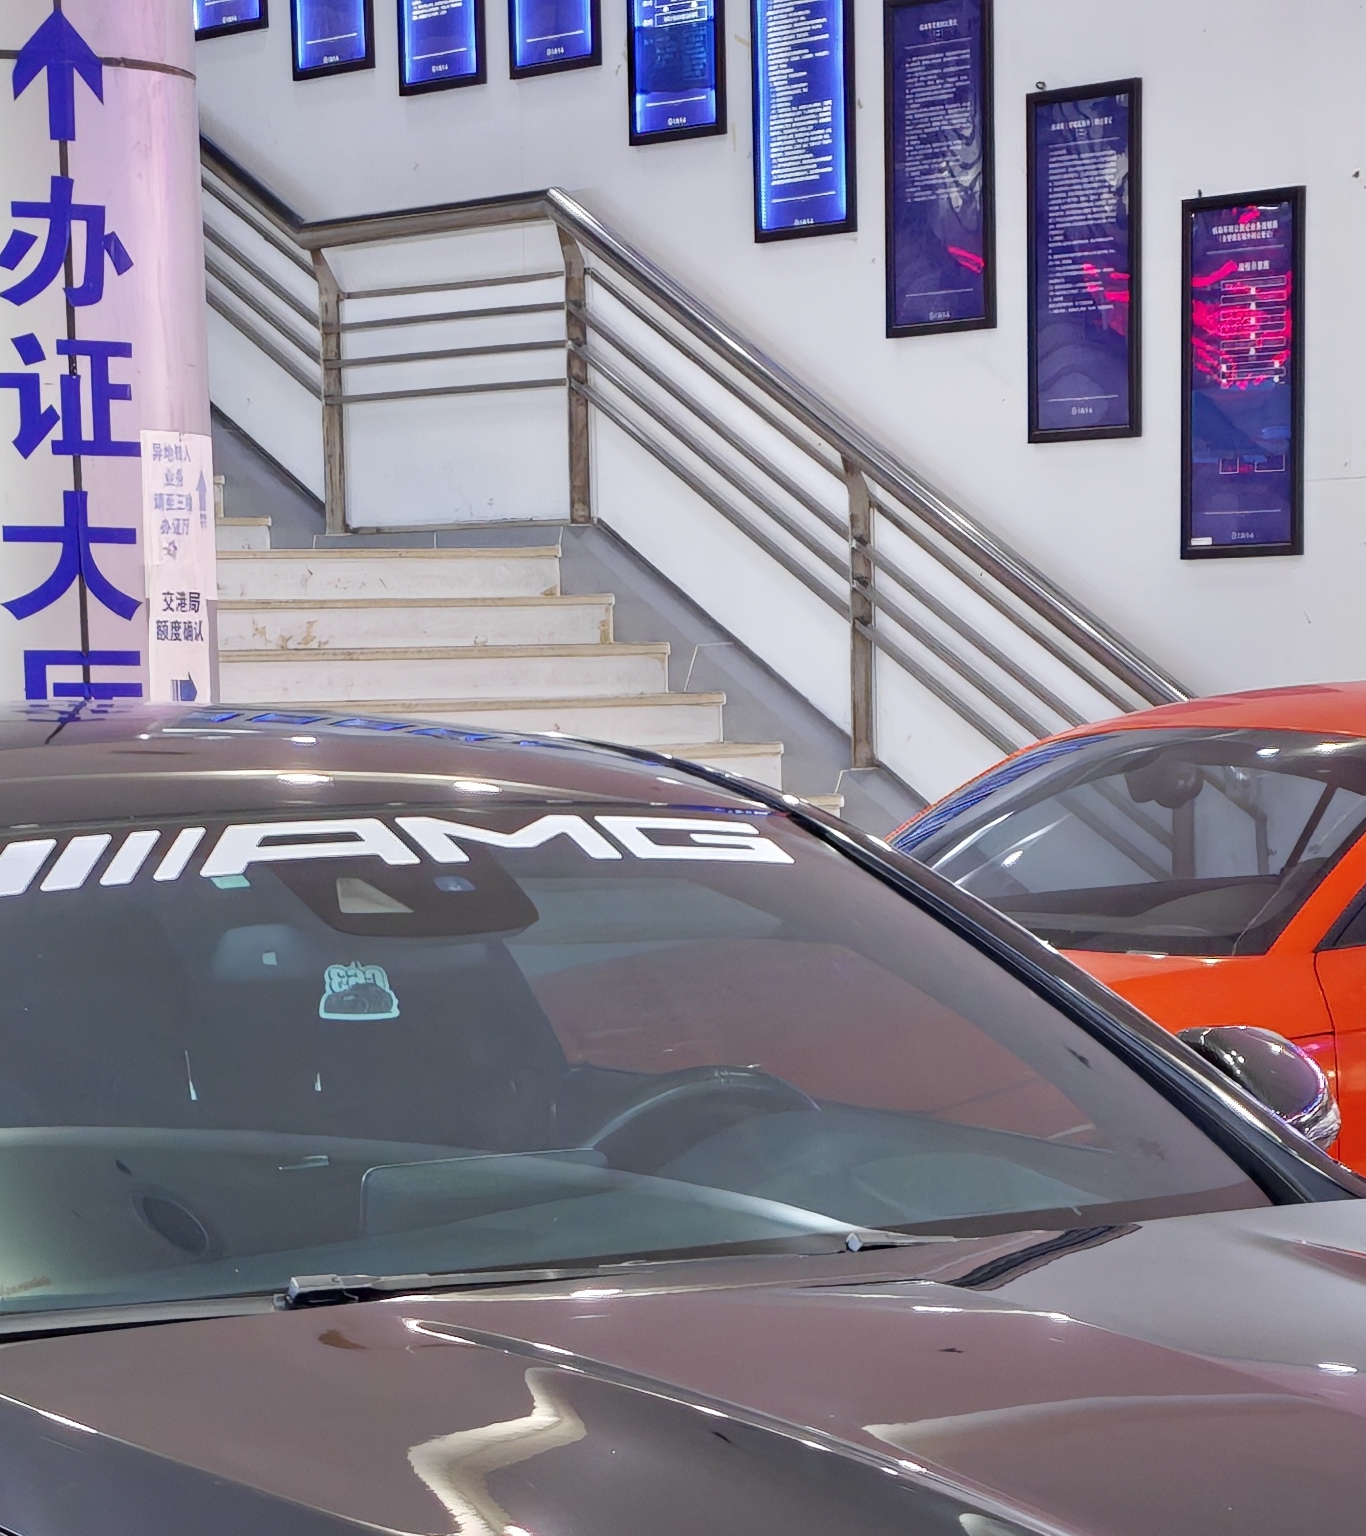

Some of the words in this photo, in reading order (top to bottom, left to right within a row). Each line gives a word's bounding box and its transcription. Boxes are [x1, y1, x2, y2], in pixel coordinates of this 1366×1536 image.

[156, 620, 204, 642] 额度确认
[200, 814, 795, 878] AMG
